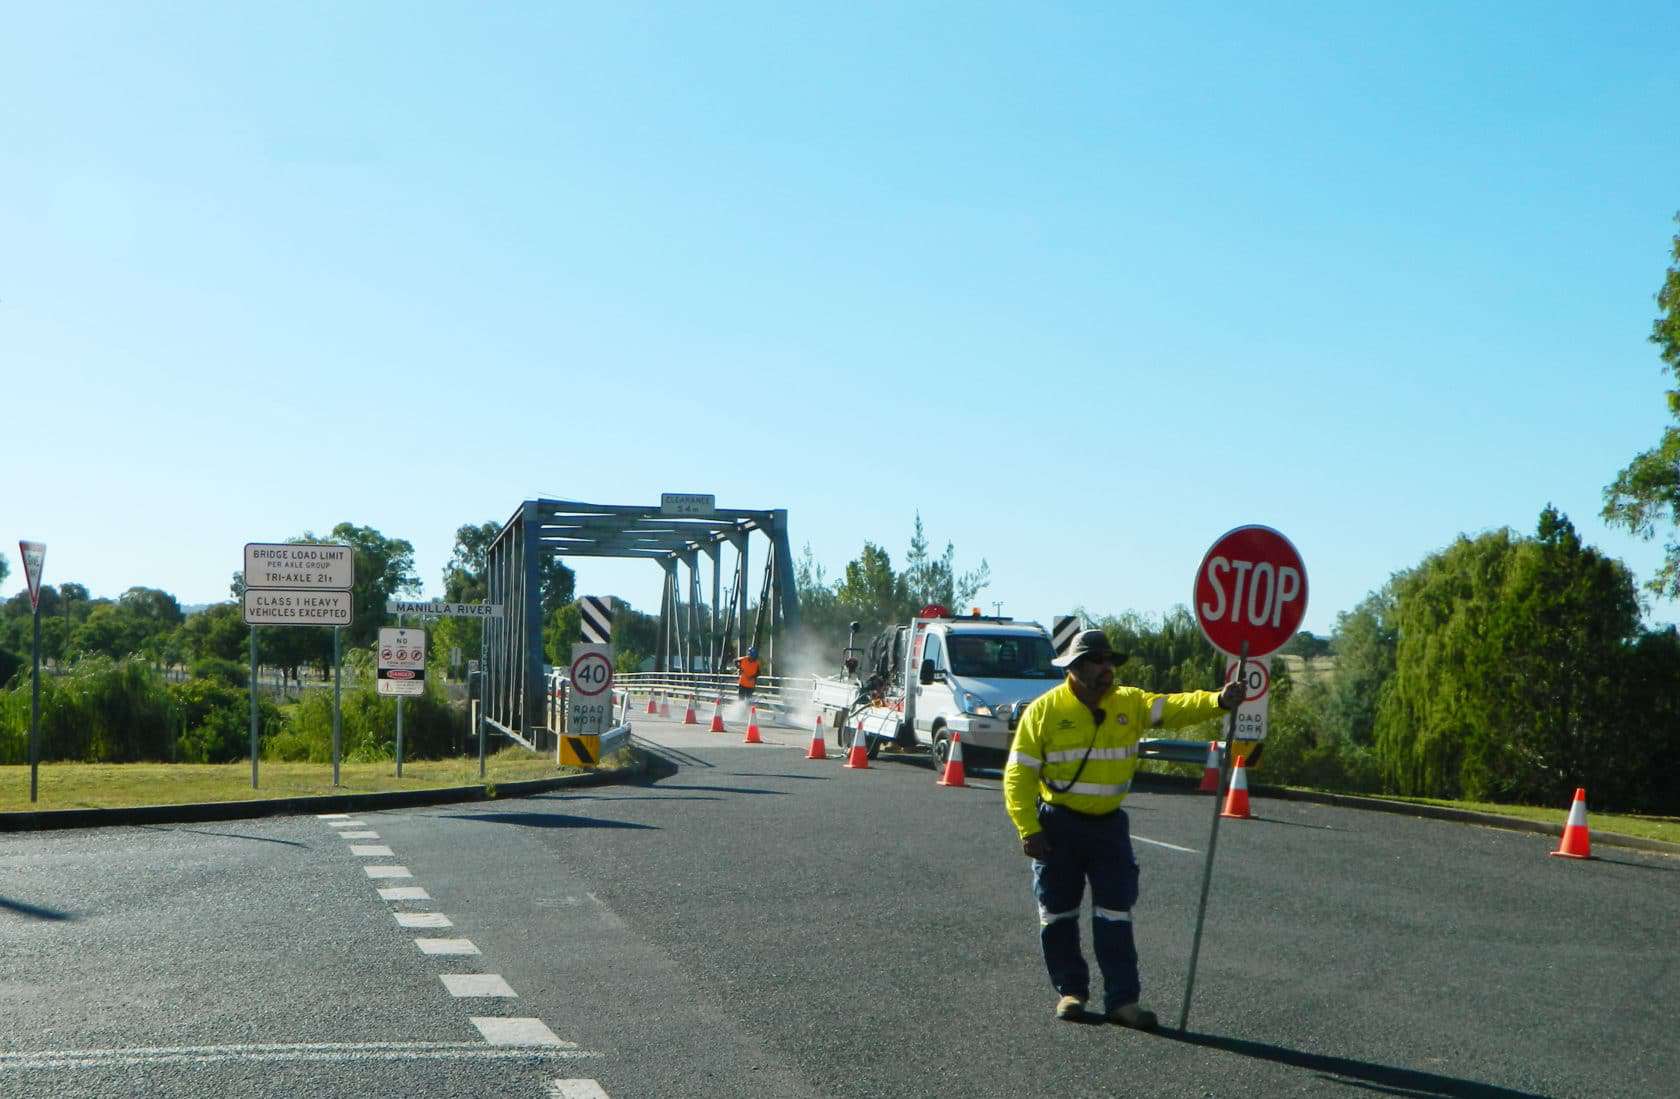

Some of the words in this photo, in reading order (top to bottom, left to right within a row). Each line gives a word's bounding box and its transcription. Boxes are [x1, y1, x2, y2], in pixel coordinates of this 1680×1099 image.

[253, 550, 288, 559] BRIDGE
[291, 551, 317, 560] LOAD
[320, 551, 344, 560] LIMIT
[265, 573, 312, 582] TRI-AXLE
[1202, 555, 1299, 628] STOP
[256, 597, 291, 606] CLASS
[304, 598, 339, 607] HEAVY
[249, 608, 296, 617] VEHICLES
[299, 609, 347, 618] EXCEPTED
[396, 602, 451, 613] MANILLA
[457, 605, 492, 615] RIVER
[578, 664, 606, 684] 40
[574, 704, 604, 713] ROAD
[1238, 713, 1262, 723] OAD
[1238, 724, 1262, 734] ORK
